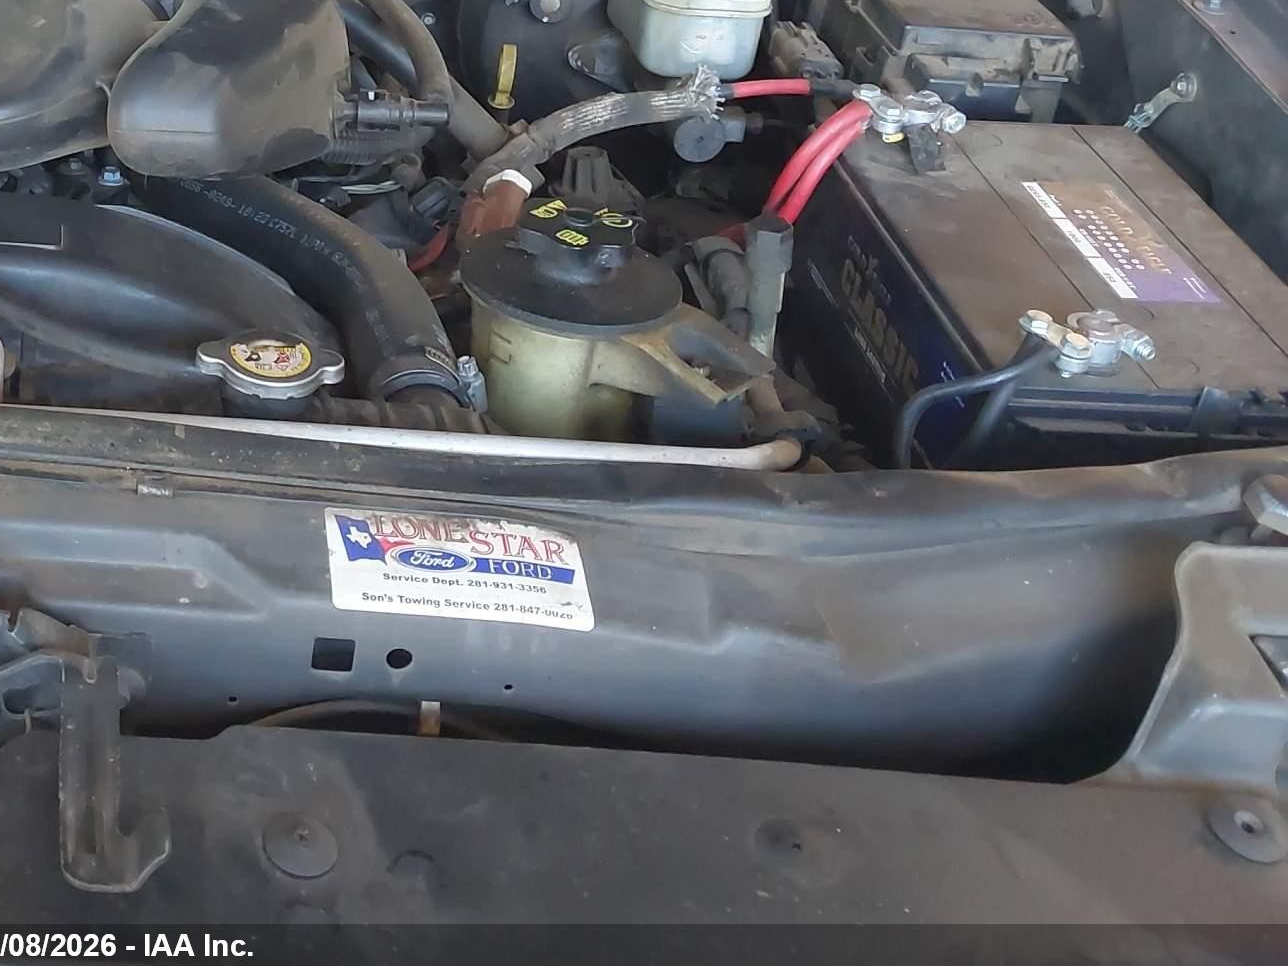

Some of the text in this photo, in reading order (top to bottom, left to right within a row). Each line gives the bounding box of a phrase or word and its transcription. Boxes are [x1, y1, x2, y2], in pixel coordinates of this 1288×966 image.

[373, 514, 569, 565] LONE STAR
[409, 549, 456, 569] Ford
[489, 558, 553, 580] FORD
[383, 572, 548, 594] Service Dept. 281-931-3356
[361, 592, 394, 603] Son's
[396, 595, 441, 608] Towing
[444, 598, 490, 611] Service
